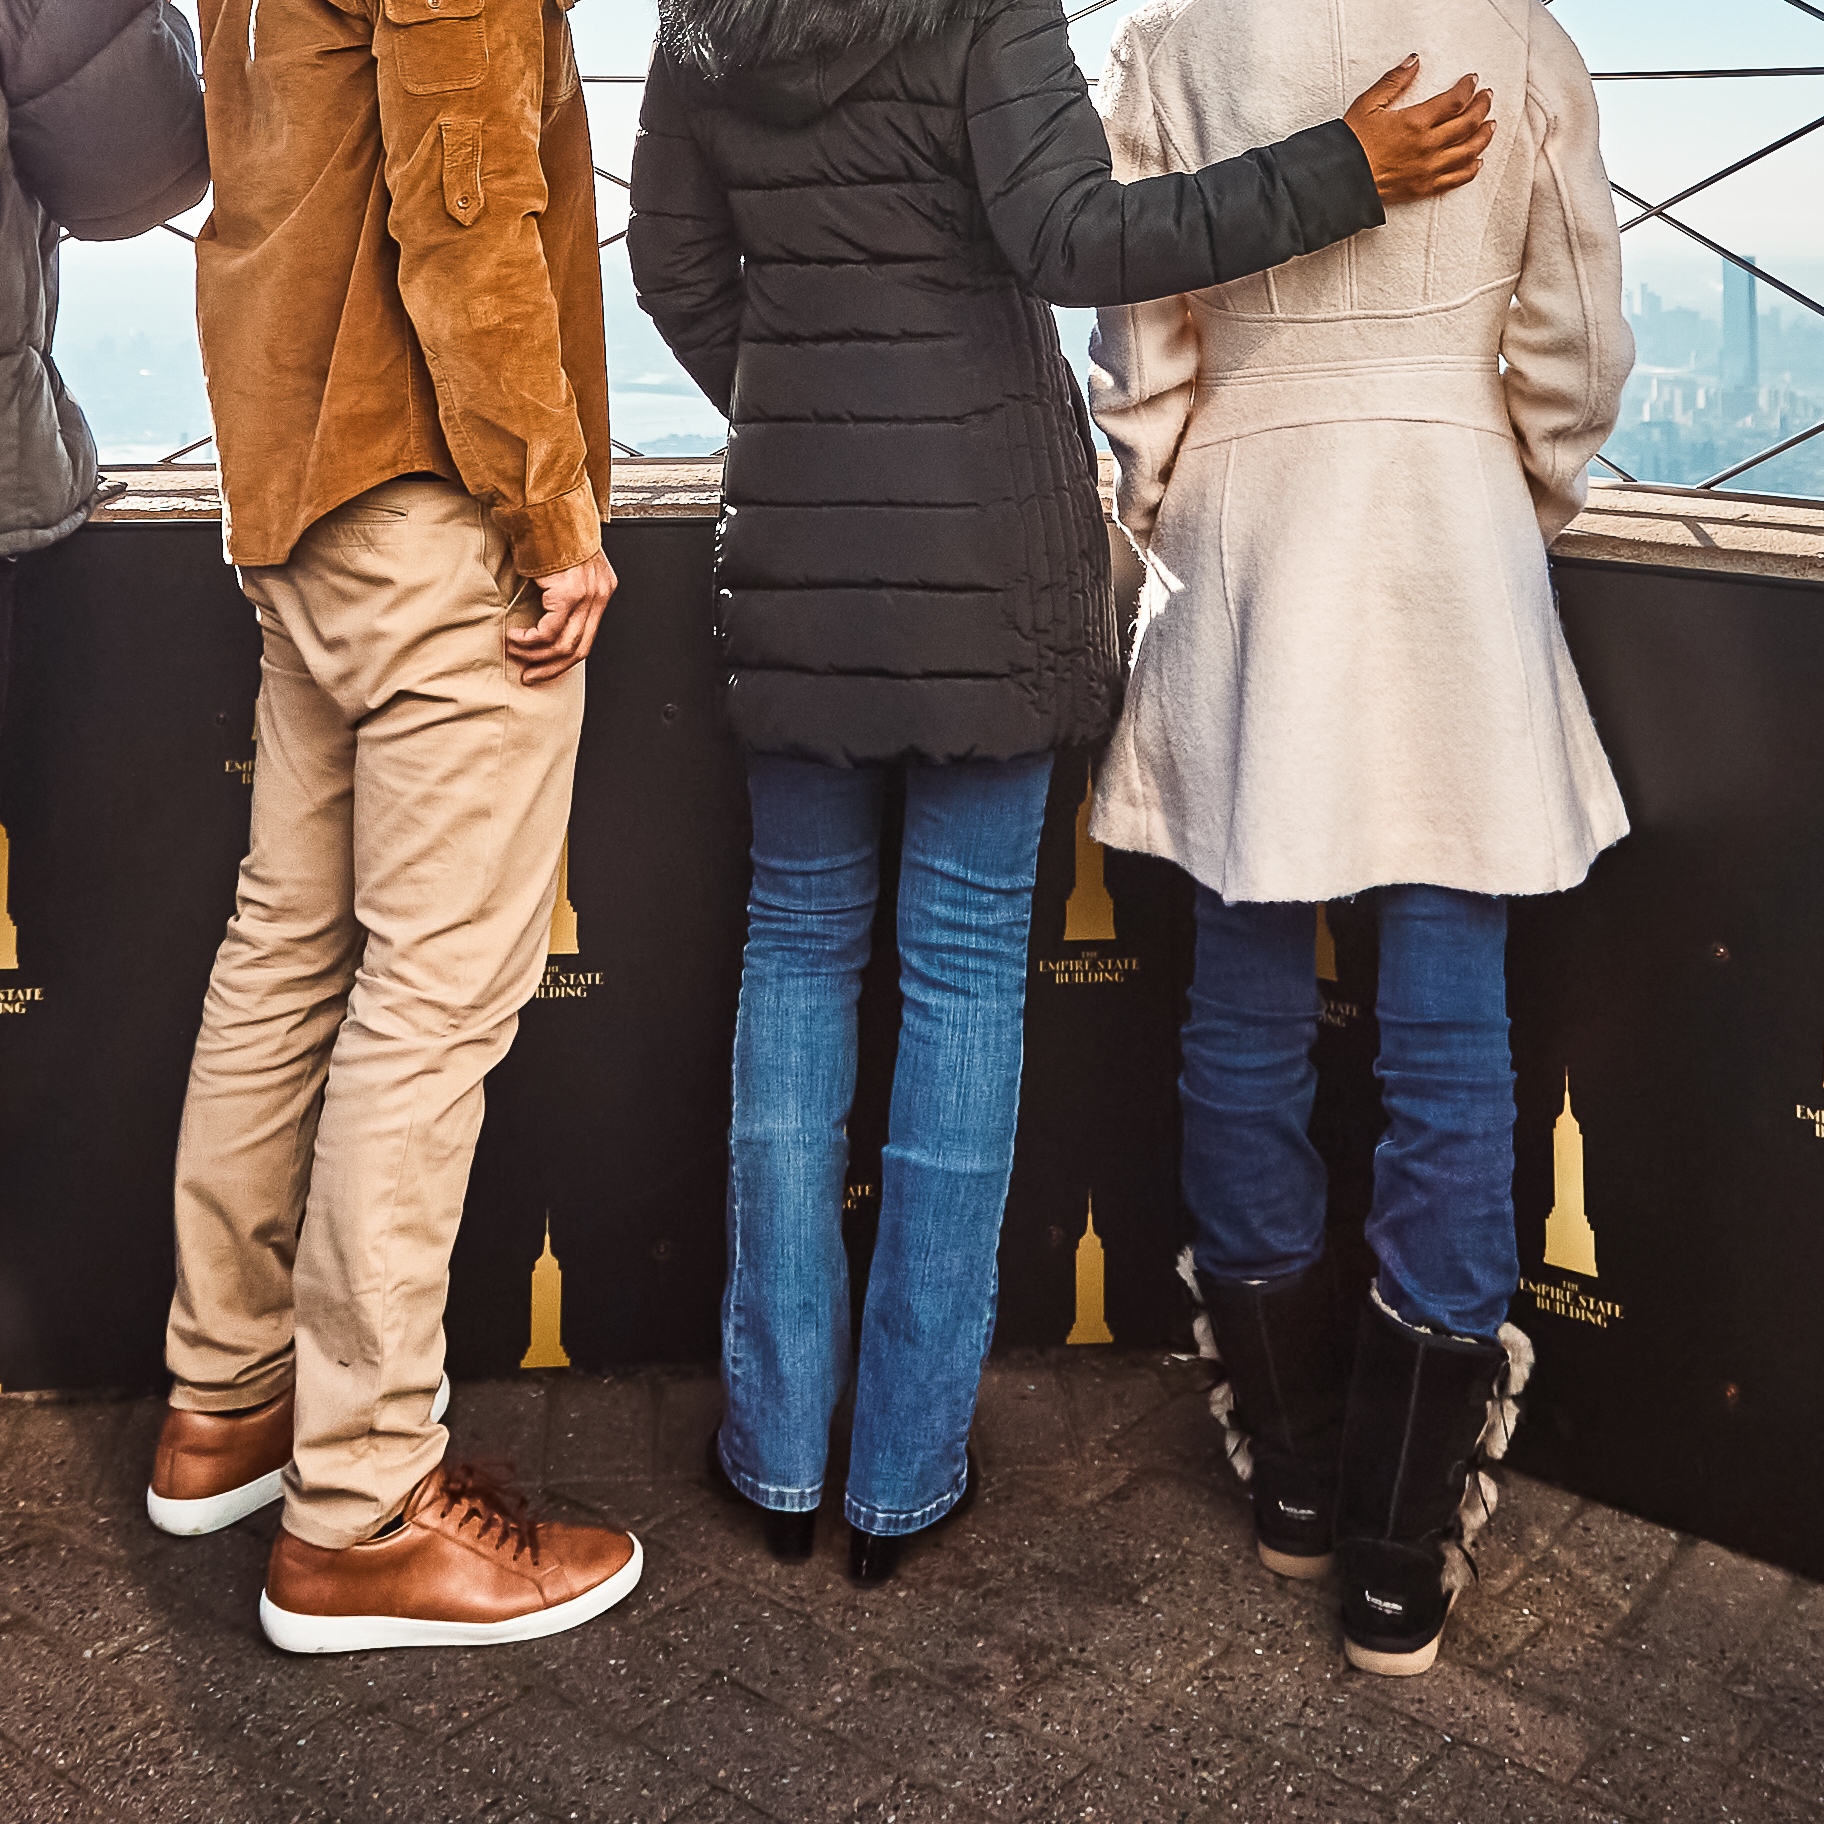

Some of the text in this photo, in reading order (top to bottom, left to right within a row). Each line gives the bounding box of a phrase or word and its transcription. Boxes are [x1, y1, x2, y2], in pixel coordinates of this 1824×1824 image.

[1039, 958, 1140, 972] EMPIRE STATE
[559, 972, 605, 985] STATE
[1056, 971, 1124, 984] BUILDING
[536, 986, 587, 999] ILDING
[1562, 1280, 1578, 1292] THE
[1520, 1277, 1625, 1320] EMPIRE STATE
[1536, 1296, 1608, 1329] BUILDING
